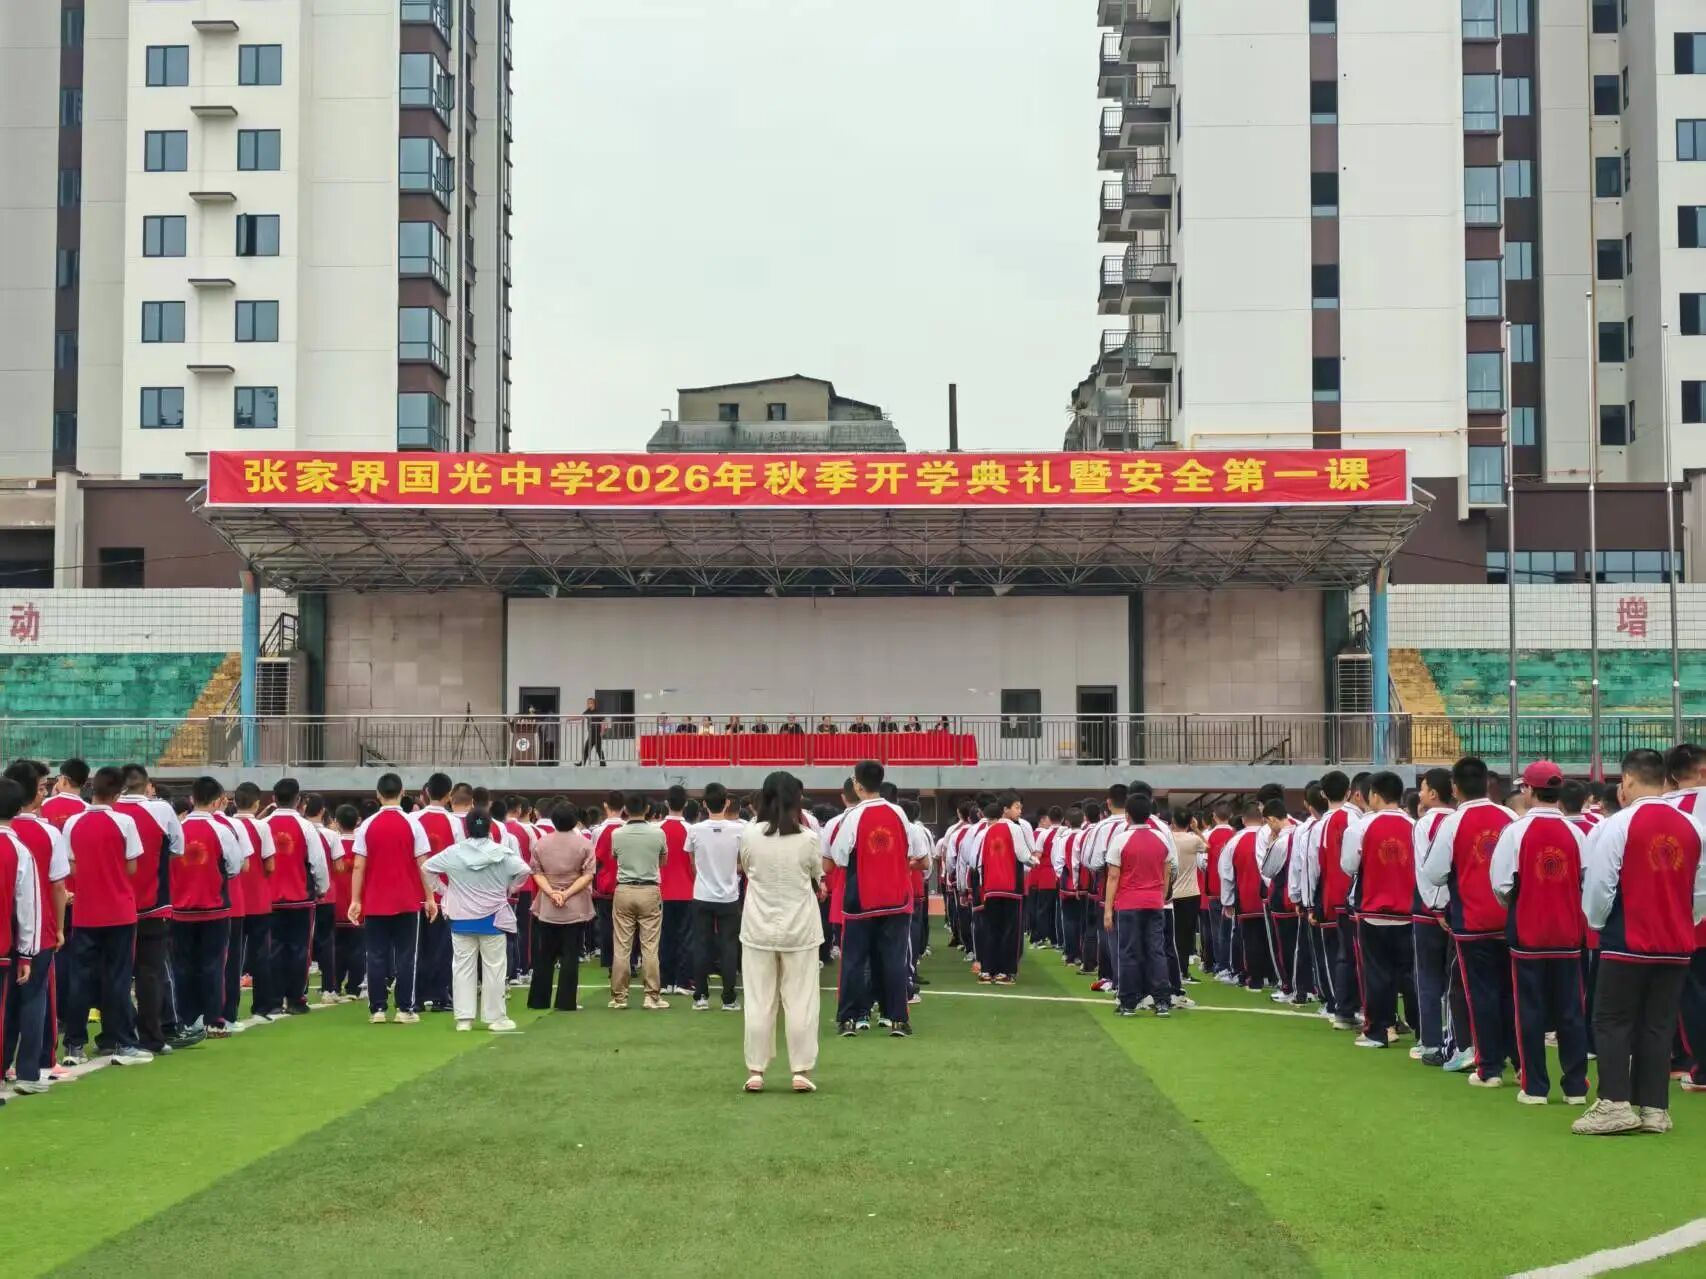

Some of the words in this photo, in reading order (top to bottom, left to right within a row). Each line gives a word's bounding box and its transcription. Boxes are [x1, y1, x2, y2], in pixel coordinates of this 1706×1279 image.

[244, 457, 1370, 496] 张家界国光中学2026年秋季开学典礼暨安全第一课
[10, 602, 40, 642] 动
[1616, 596, 1648, 637] 增
